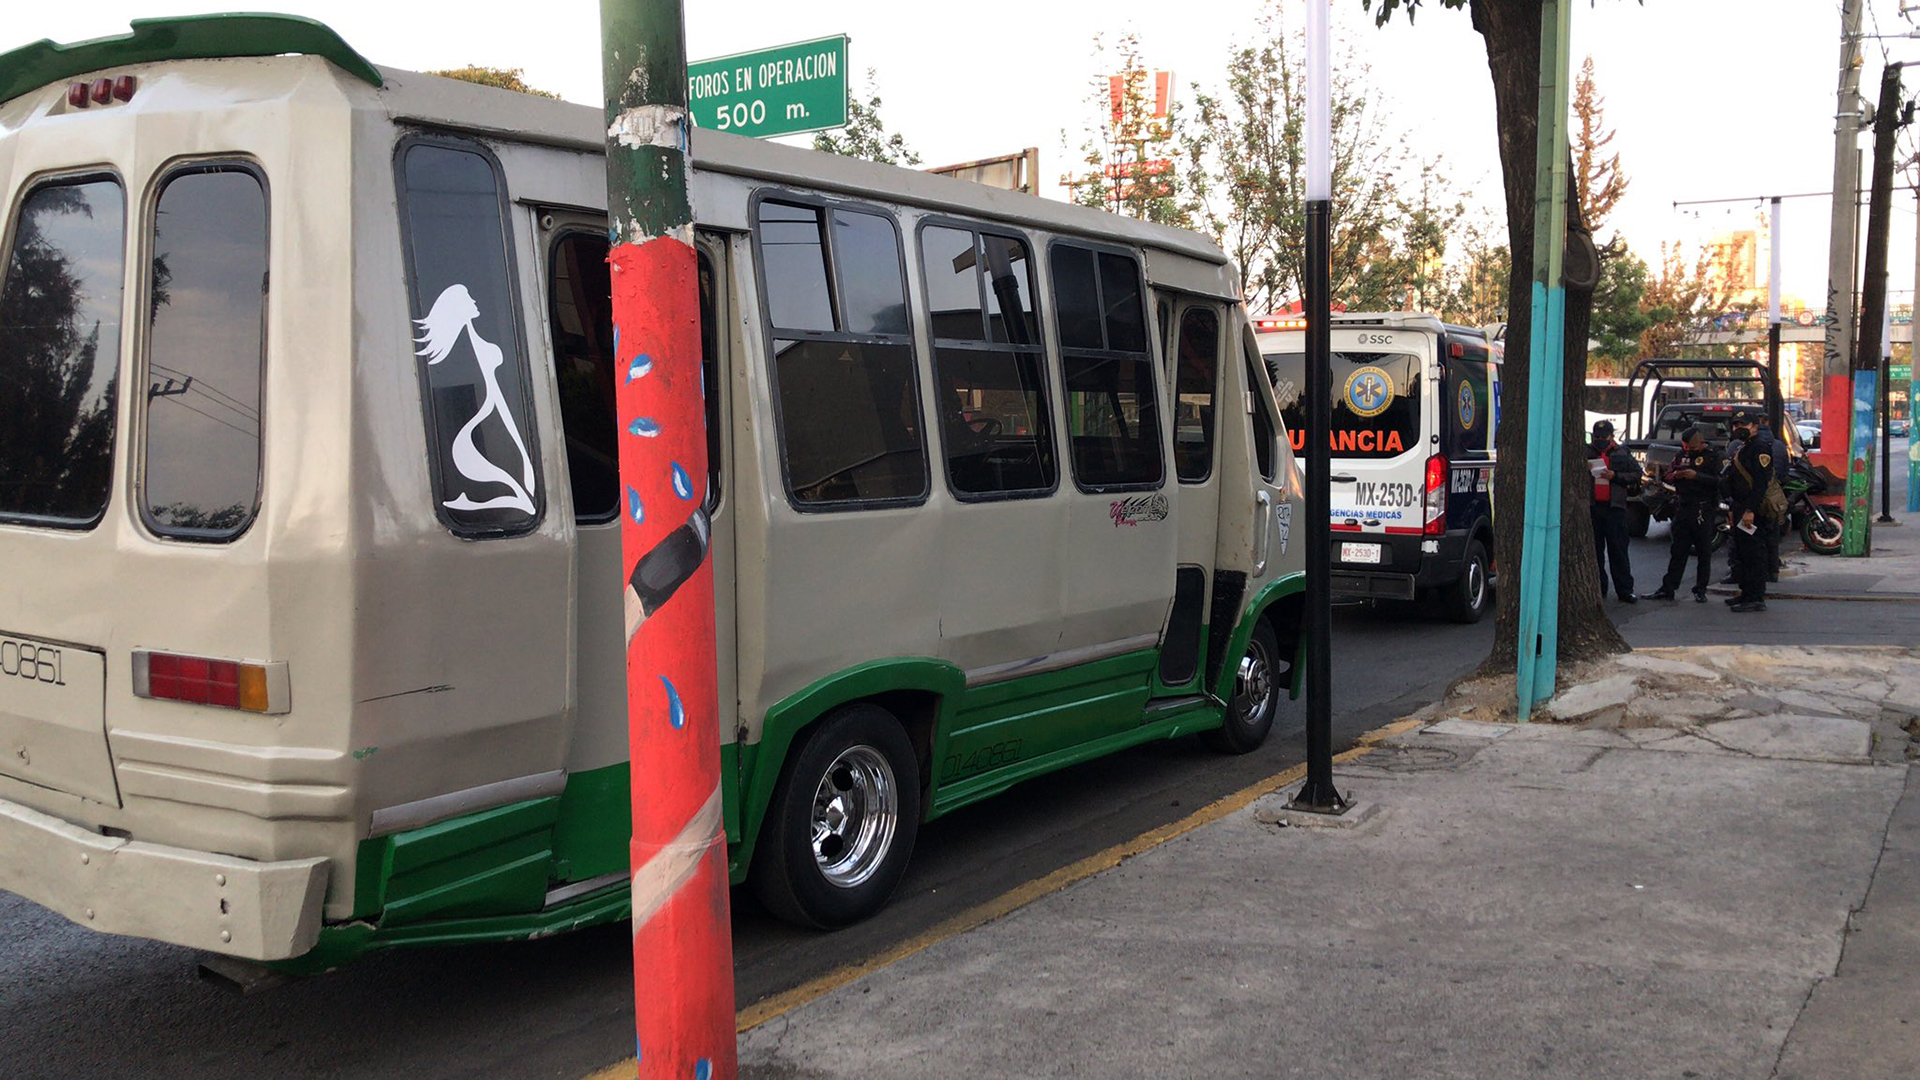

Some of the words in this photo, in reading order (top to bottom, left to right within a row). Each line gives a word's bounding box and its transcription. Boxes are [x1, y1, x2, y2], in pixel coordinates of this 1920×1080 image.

[689, 70, 729, 100] FOROS
[736, 66, 752, 92] EN
[759, 51, 836, 88] OPERACION
[717, 99, 766, 130] 500
[786, 102, 810, 120] m.
[1370, 334, 1393, 345] SSC
[1355, 482, 1424, 508] MX-253D-1
[1366, 510, 1402, 519] MEDICAS
[0, 640, 66, 686] 0861
